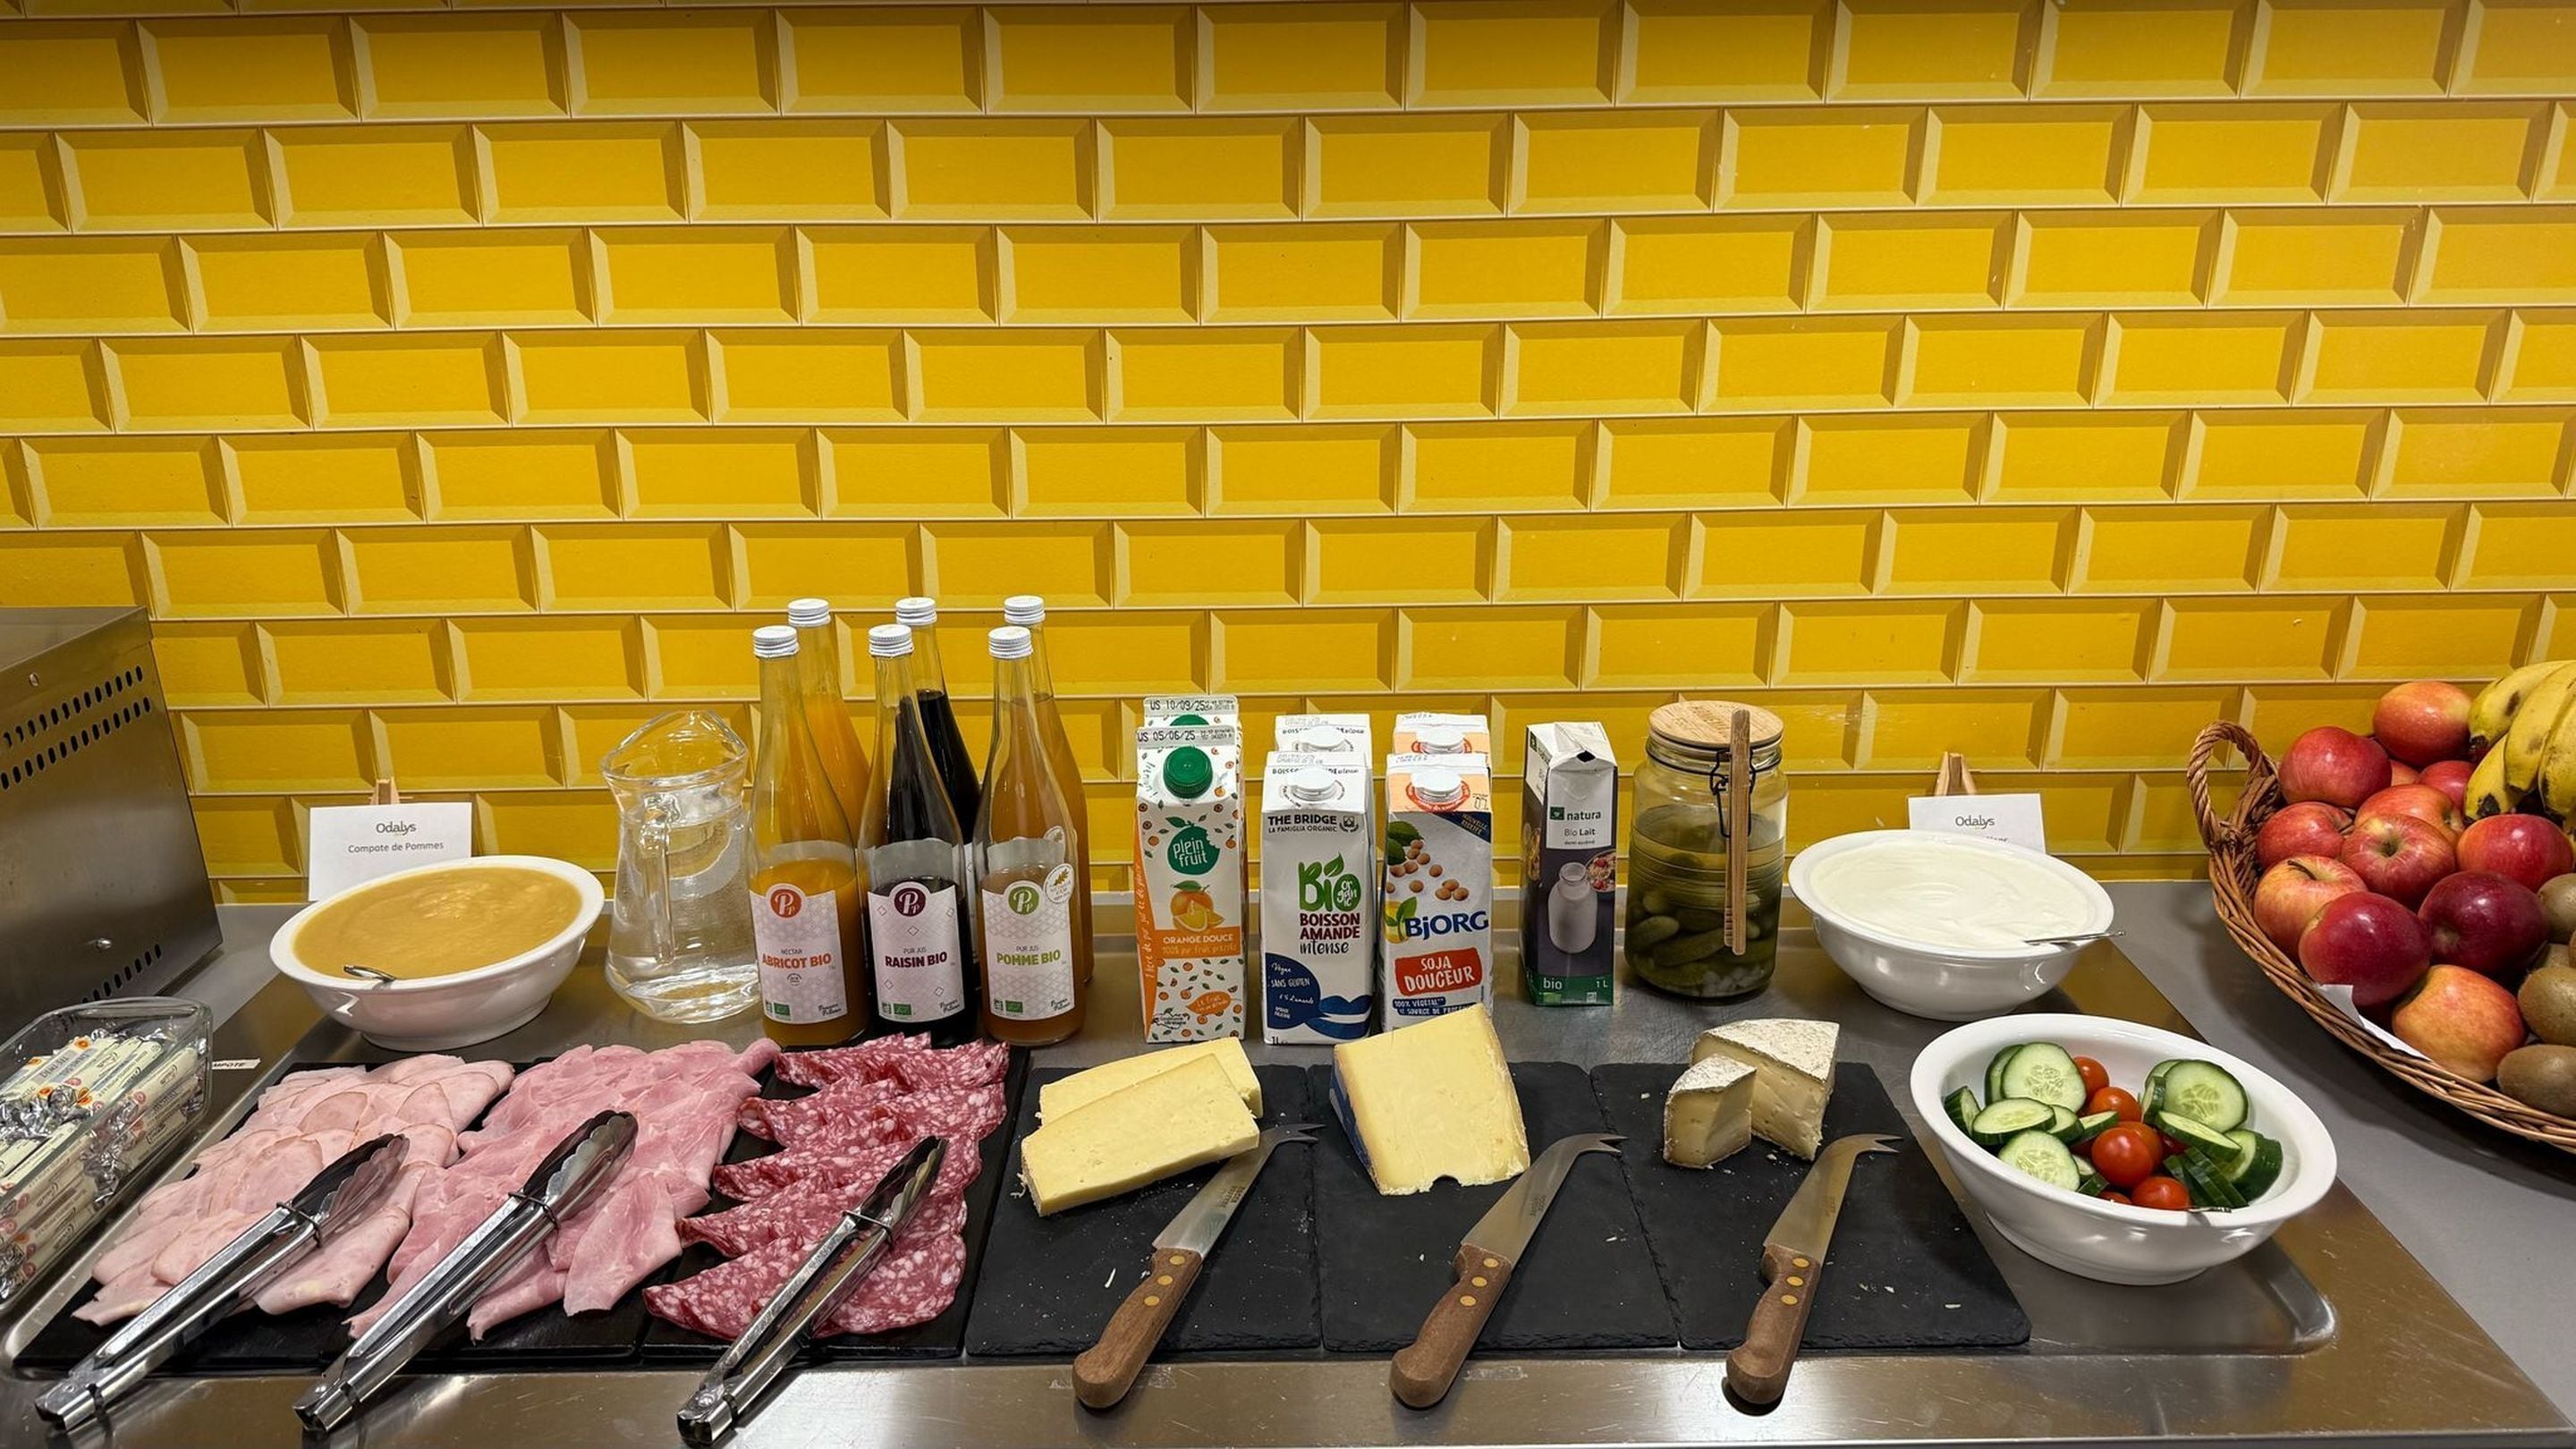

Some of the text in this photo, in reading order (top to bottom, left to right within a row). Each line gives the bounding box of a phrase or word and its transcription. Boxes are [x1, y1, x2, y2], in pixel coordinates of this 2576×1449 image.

[1153, 730, 1196, 741] 05/06/25
[1267, 814, 1337, 826] THE BRIDGE
[1566, 811, 1601, 820] natura
[1955, 815, 1995, 829] Odalys
[376, 821, 417, 835] Odalys
[1580, 827, 1596, 835] Lait
[348, 842, 444, 853] Compote de Pommes
[1173, 837, 1204, 859] plein
[1179, 851, 1208, 867] fruit
[1300, 912, 1360, 927] BOISSON
[1163, 934, 1234, 945] ORANGE DOUCE
[1300, 926, 1360, 940] AMANDE
[1300, 939, 1349, 955] intense
[762, 953, 832, 969] ABRICOT BIO
[886, 952, 947, 968] RAISIN BIO
[996, 949, 1061, 966] POMME BIO
[1420, 955, 1452, 970] SOJA
[1403, 966, 1475, 992] DOUCEUR
[1543, 978, 1563, 989] bio
